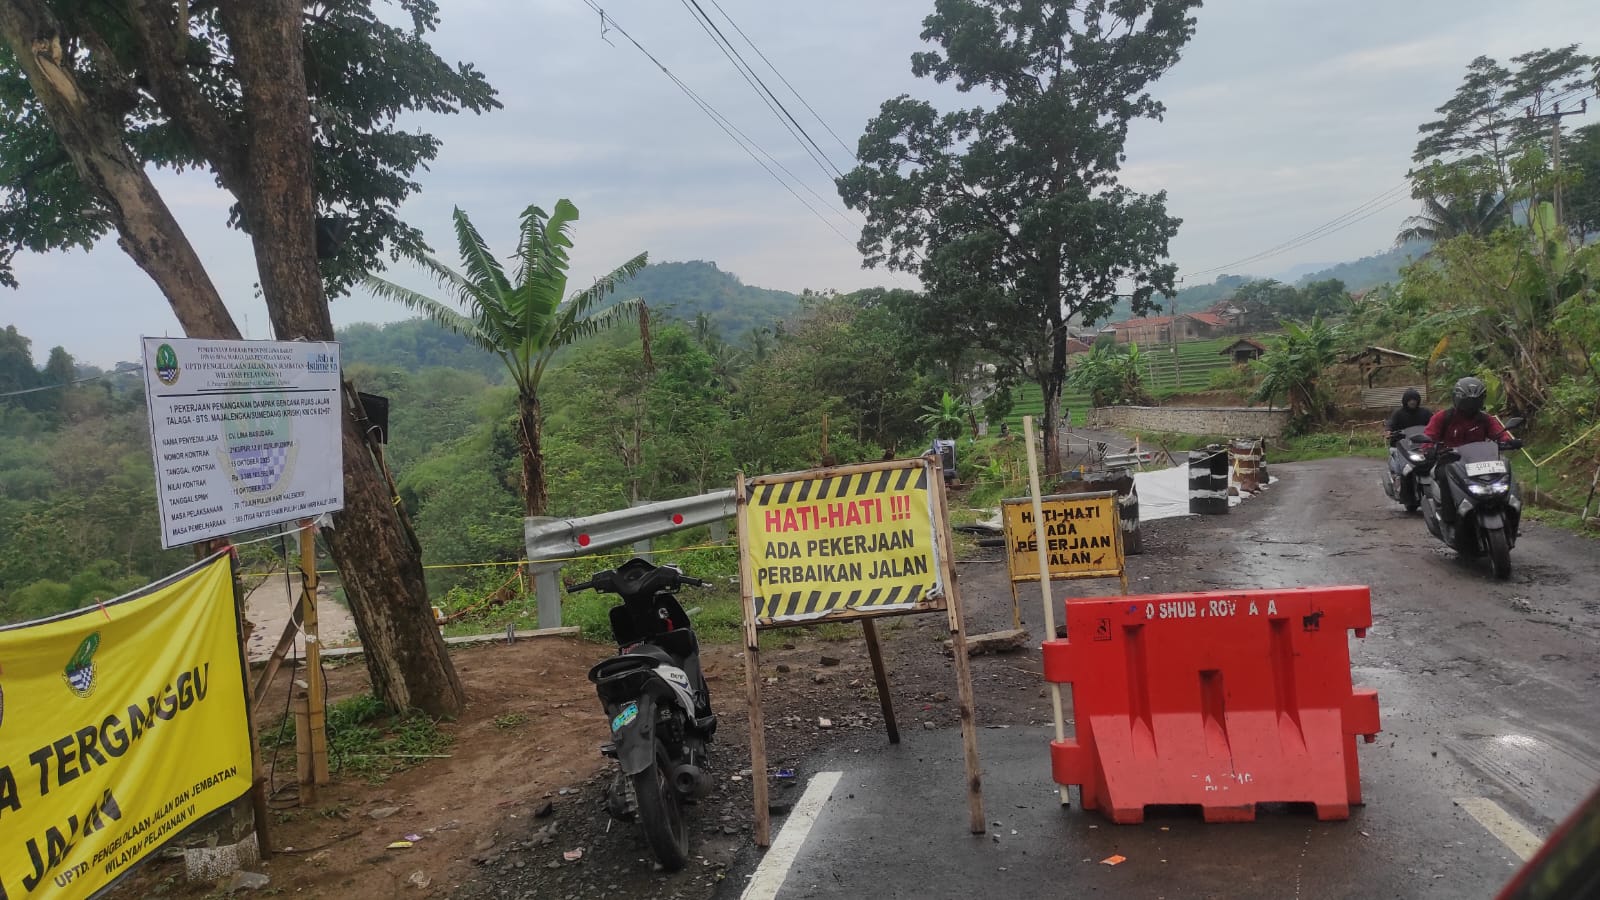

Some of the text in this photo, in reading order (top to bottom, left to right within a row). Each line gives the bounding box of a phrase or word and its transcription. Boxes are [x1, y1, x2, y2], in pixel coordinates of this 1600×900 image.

[185, 362, 201, 370] UPTD
[203, 362, 246, 370] PENGELOLAAN
[248, 361, 265, 369] JALAN
[215, 371, 242, 379] WILAYAH
[174, 402, 211, 413] PEKERJAAN
[212, 399, 251, 411] PENANGANAN
[252, 399, 275, 408] DAMPAK
[276, 397, 300, 407] BENCANA
[167, 415, 191, 425] TALAGA
[196, 413, 210, 423] BTS.
[211, 409, 281, 422] MAJALENGKA/SUMEDANG
[178, 434, 205, 445] PENYEDIA
[205, 433, 219, 442] JASA
[164, 448, 209, 461] NOMOR KONTRAK
[166, 463, 217, 476] TANGGAL KONTRAK
[167, 479, 208, 491] NILAI KONTRAK
[169, 494, 194, 506] TANGGAL
[171, 504, 223, 521] MASA PELAKSANAAN
[765, 495, 911, 533] HATI-HATI !!!
[1021, 506, 1100, 523] HTI-HATI
[172, 519, 227, 536] MASA PEMELIHARAAN
[1047, 523, 1077, 536] ADA
[765, 529, 914, 559] ADA PEKERJAAN
[1017, 535, 1111, 552] PEERJAAN
[1047, 552, 1091, 566] ALAN
[758, 554, 928, 586] PERBAIKAN JALAN
[29, 662, 209, 796] TERGANGGU
[54, 765, 237, 888] UPTD. PENGELOLAAN JALAN DAN JEMBATAN
[104, 804, 196, 875] WILAYAH PELAYANAN VI
